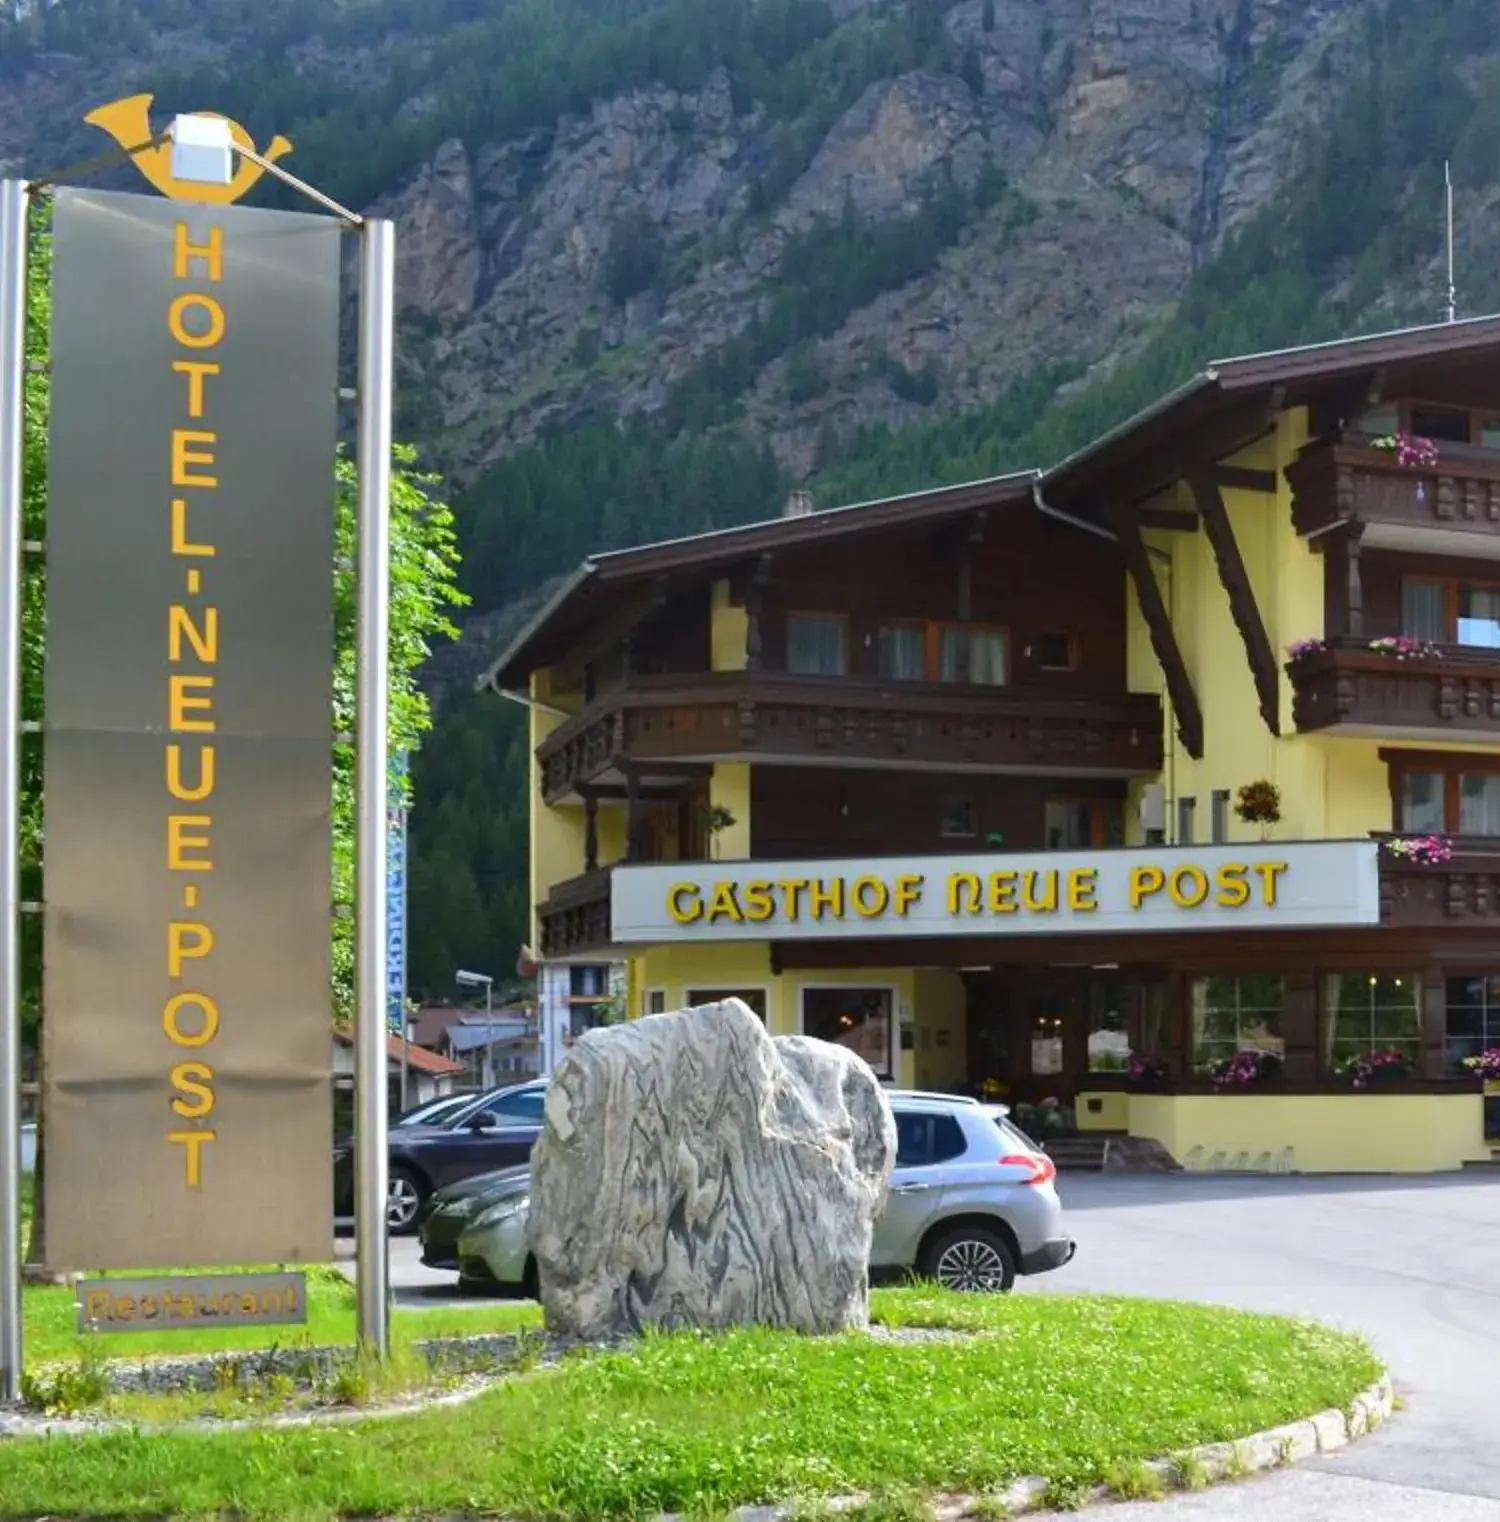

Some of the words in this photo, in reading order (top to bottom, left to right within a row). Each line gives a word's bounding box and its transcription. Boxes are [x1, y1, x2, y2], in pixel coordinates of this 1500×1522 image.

[667, 874, 923, 924] GASTHOF
[947, 867, 1098, 914] NEUE
[1129, 862, 1288, 909] POST
[87, 1280, 298, 1322] Restaurant
